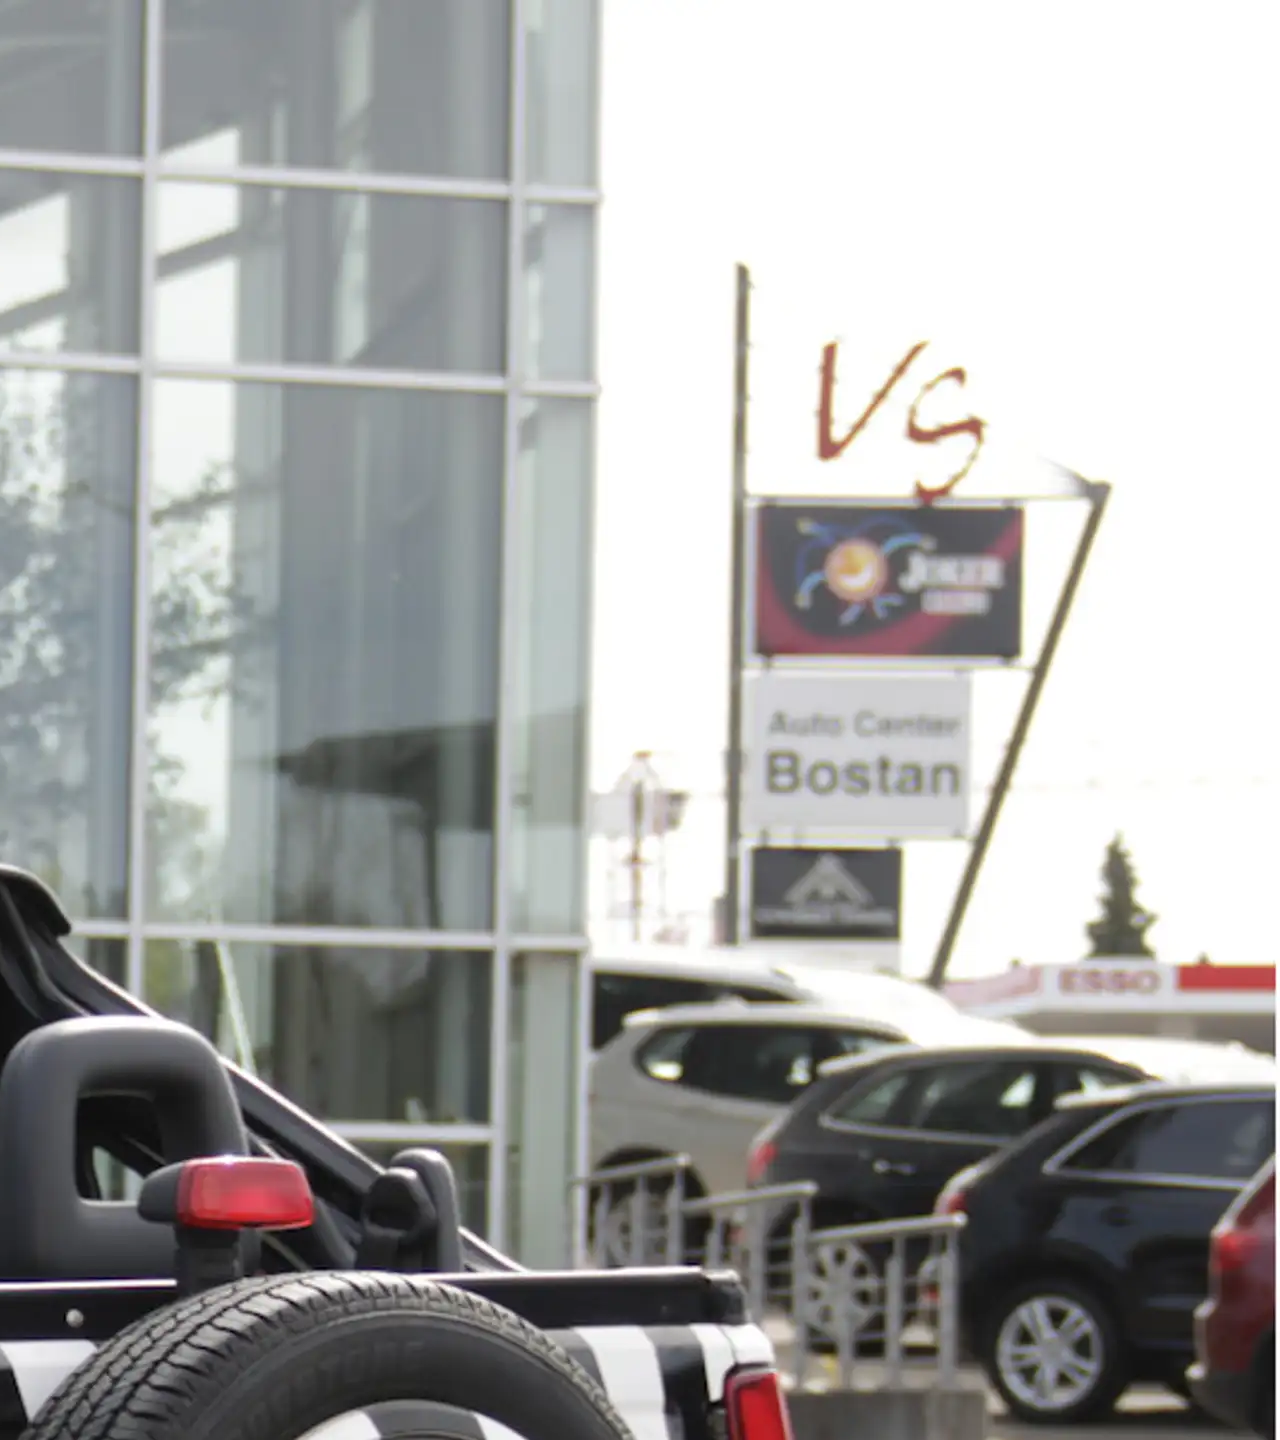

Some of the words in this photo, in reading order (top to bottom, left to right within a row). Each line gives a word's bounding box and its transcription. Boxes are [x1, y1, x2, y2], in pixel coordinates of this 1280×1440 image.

[768, 709, 843, 739] Auto
[852, 708, 961, 739] Center
[765, 749, 962, 798] Bostan
[1058, 966, 1162, 996] ESSO
